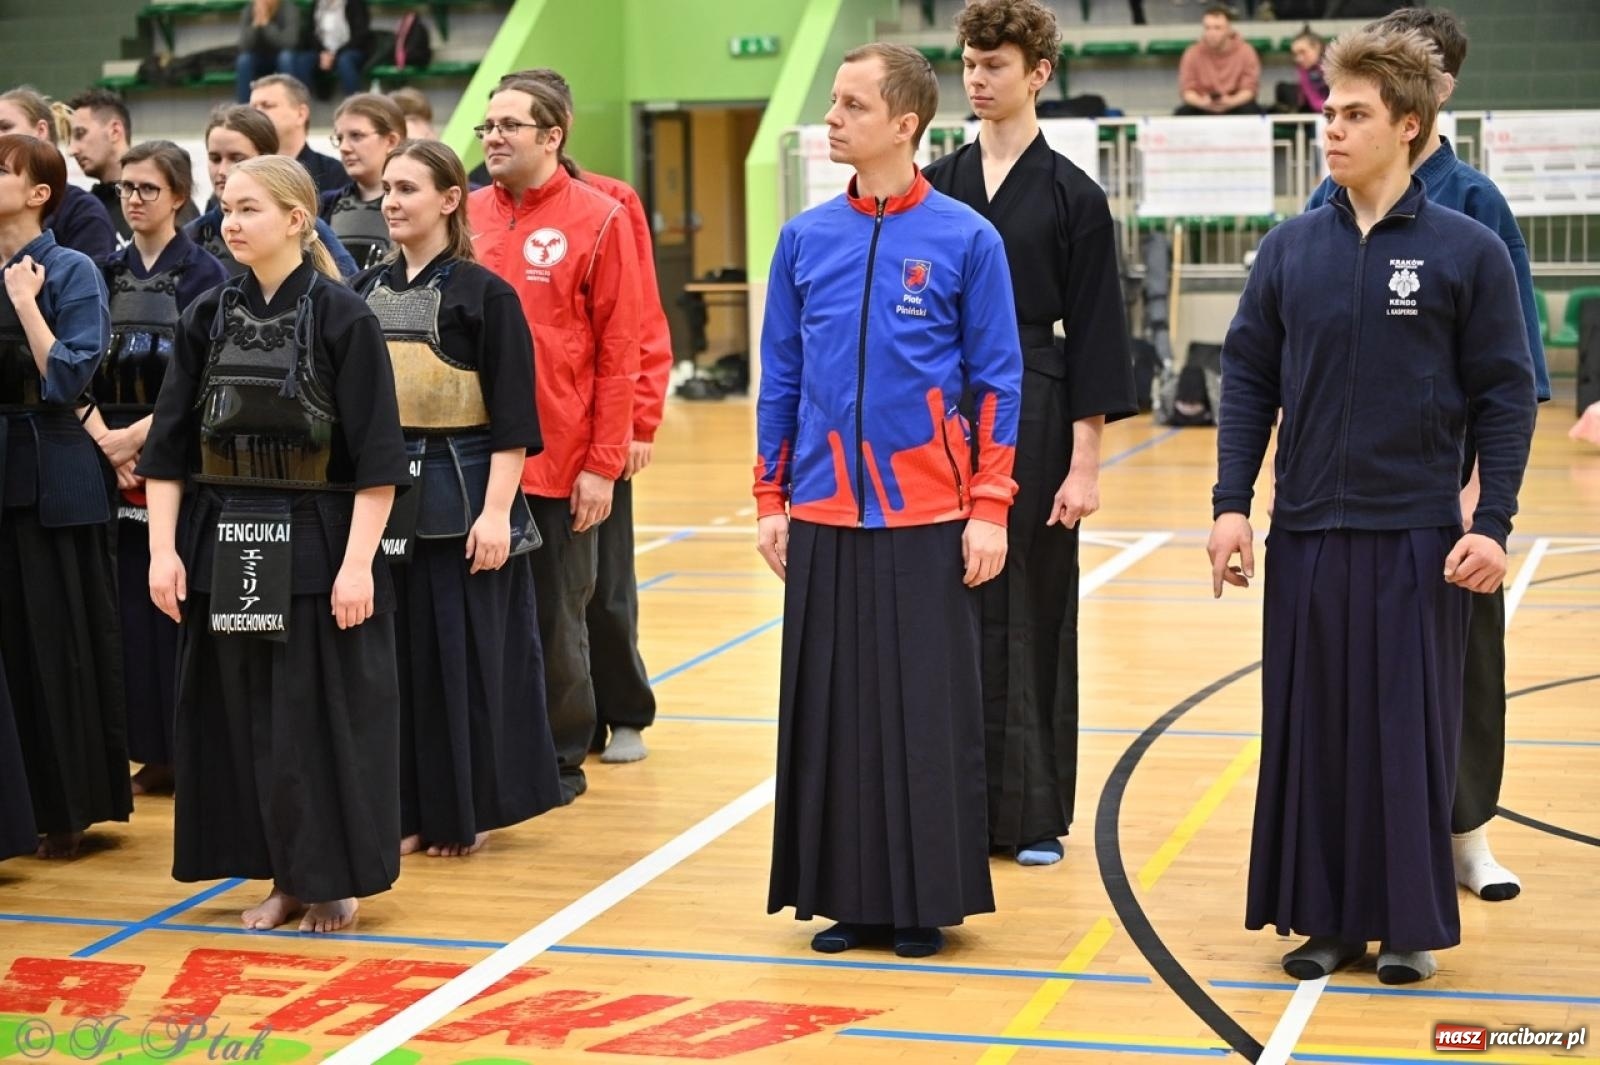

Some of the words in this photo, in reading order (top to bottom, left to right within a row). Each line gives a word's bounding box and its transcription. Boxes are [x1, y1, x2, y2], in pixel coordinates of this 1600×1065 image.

[903, 294, 922, 304] Piotr
[217, 523, 291, 542] TENGUKAI
[239, 548, 264, 612] エミリア
[211, 613, 285, 634] WOJCIECHOWSKA
